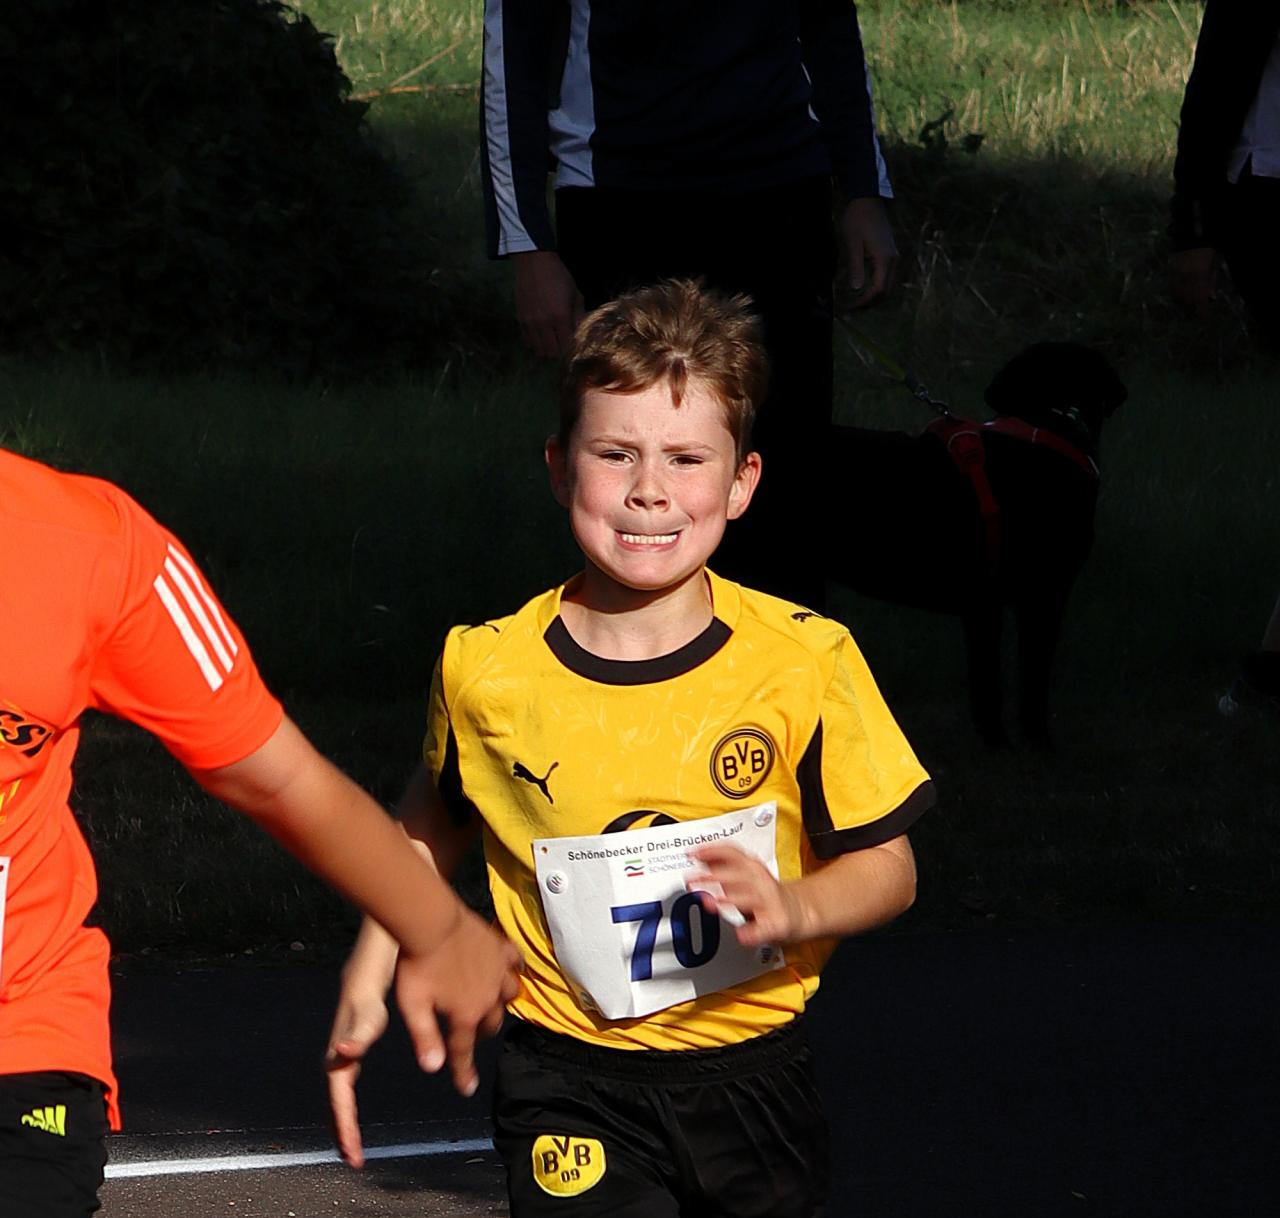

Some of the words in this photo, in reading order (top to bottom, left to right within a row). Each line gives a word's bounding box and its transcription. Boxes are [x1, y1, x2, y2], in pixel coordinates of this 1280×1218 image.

[722, 740, 765, 780] BVB
[738, 775, 752, 788] 09
[567, 844, 644, 861] Schönebecker
[647, 822, 744, 852] Drei-Brücken-Lauf
[610, 890, 721, 982] 70
[542, 1136, 591, 1175] BVB
[560, 1168, 580, 1183] 09
